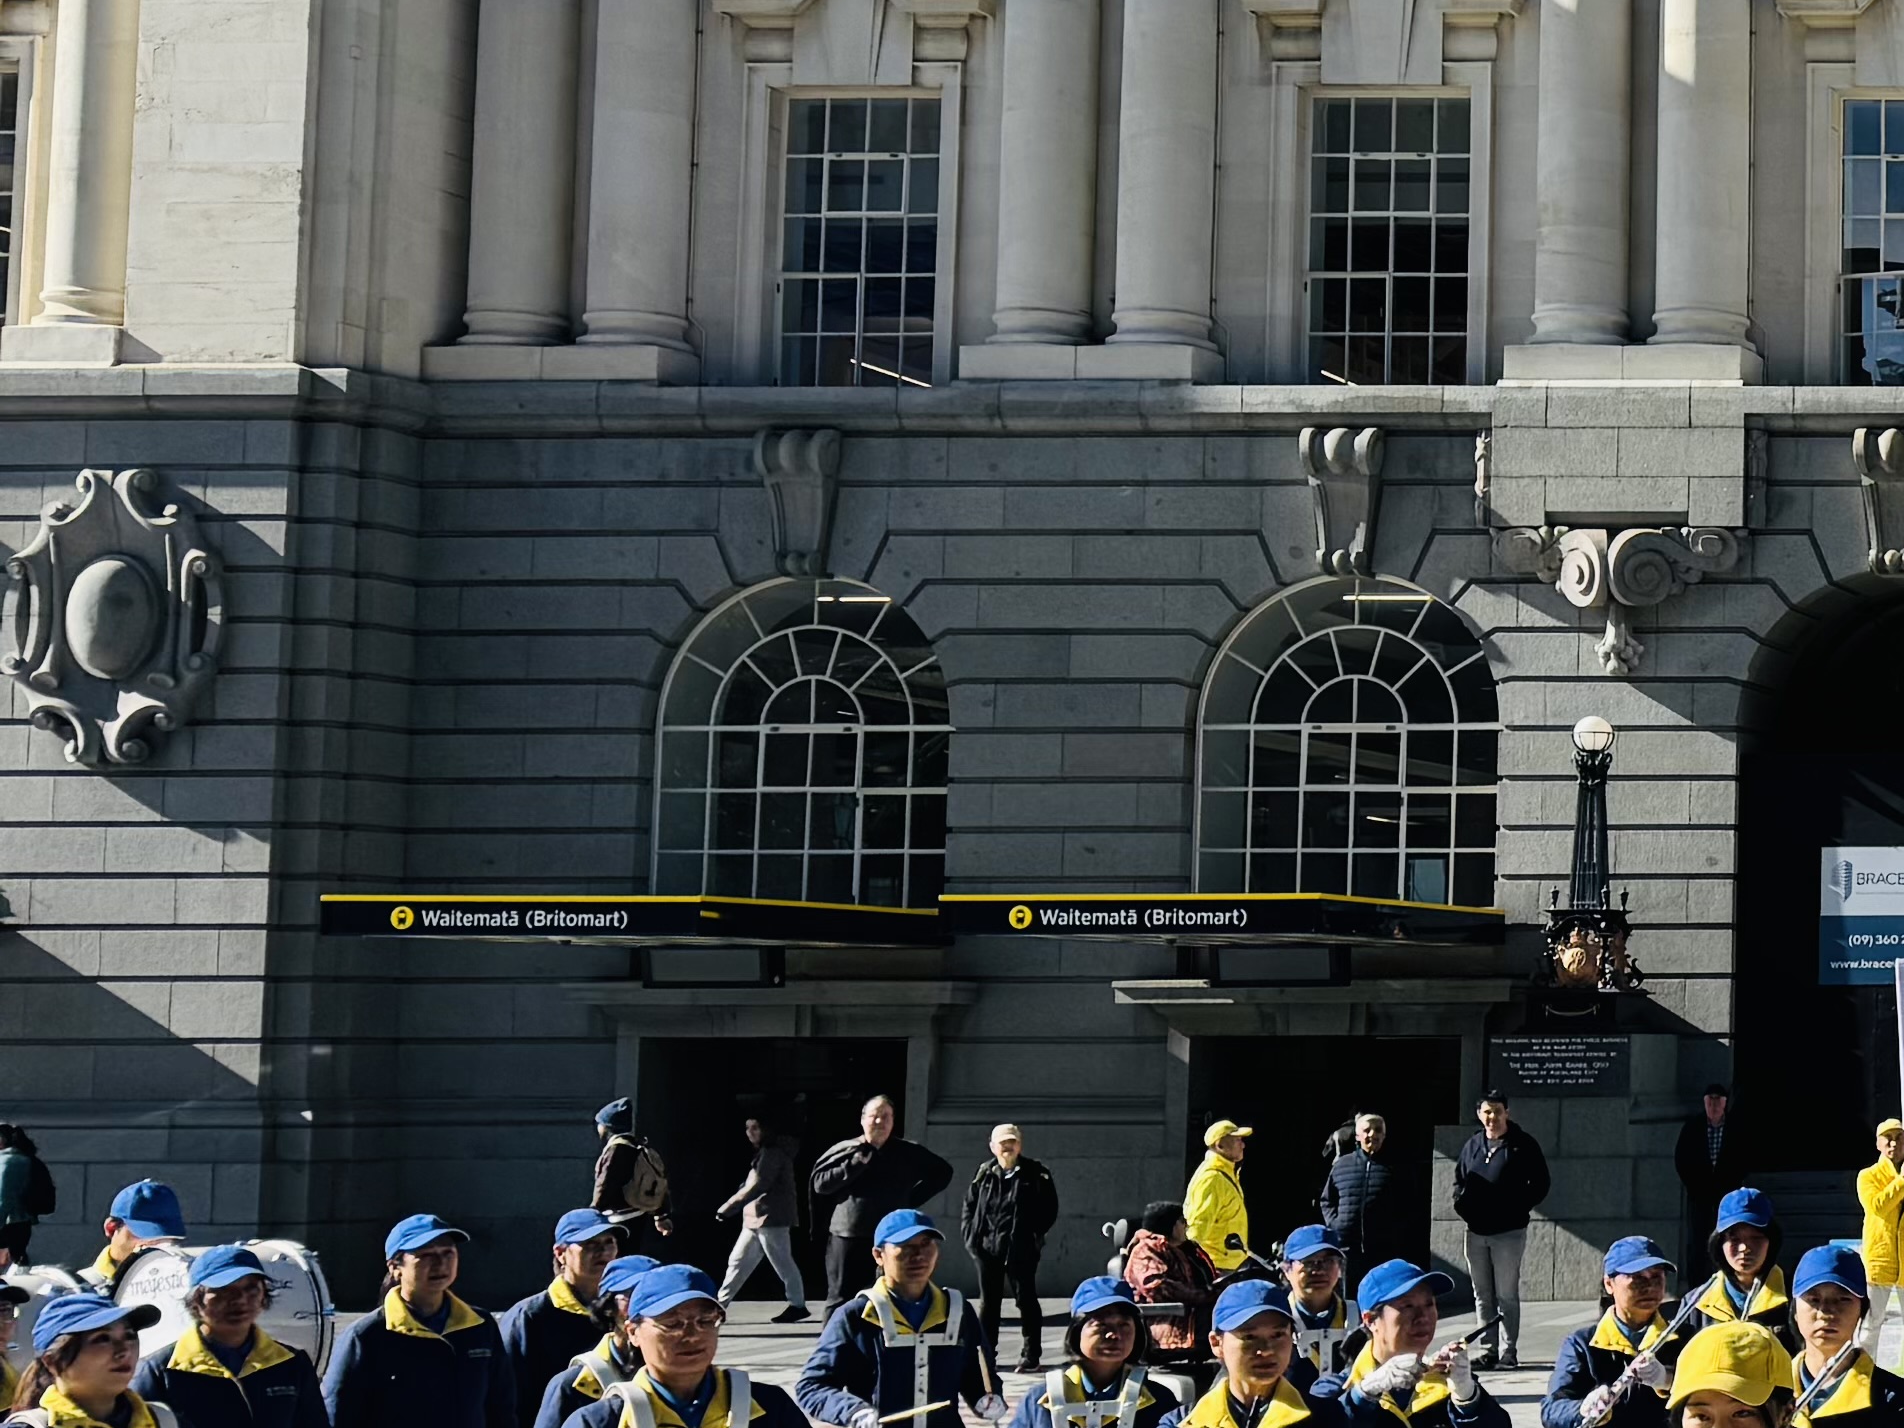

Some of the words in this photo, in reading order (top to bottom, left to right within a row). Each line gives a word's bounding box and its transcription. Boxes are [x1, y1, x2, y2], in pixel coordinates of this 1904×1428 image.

[421, 909, 519, 927] Waitematā
[525, 909, 628, 929] (Britomart)
[1040, 908, 1137, 926] Waitematā
[1144, 908, 1248, 928] (Britomart)
[1848, 934, 1873, 947] (09)
[1875, 934, 1899, 945] 360
[1830, 959, 1896, 969] www.brace
